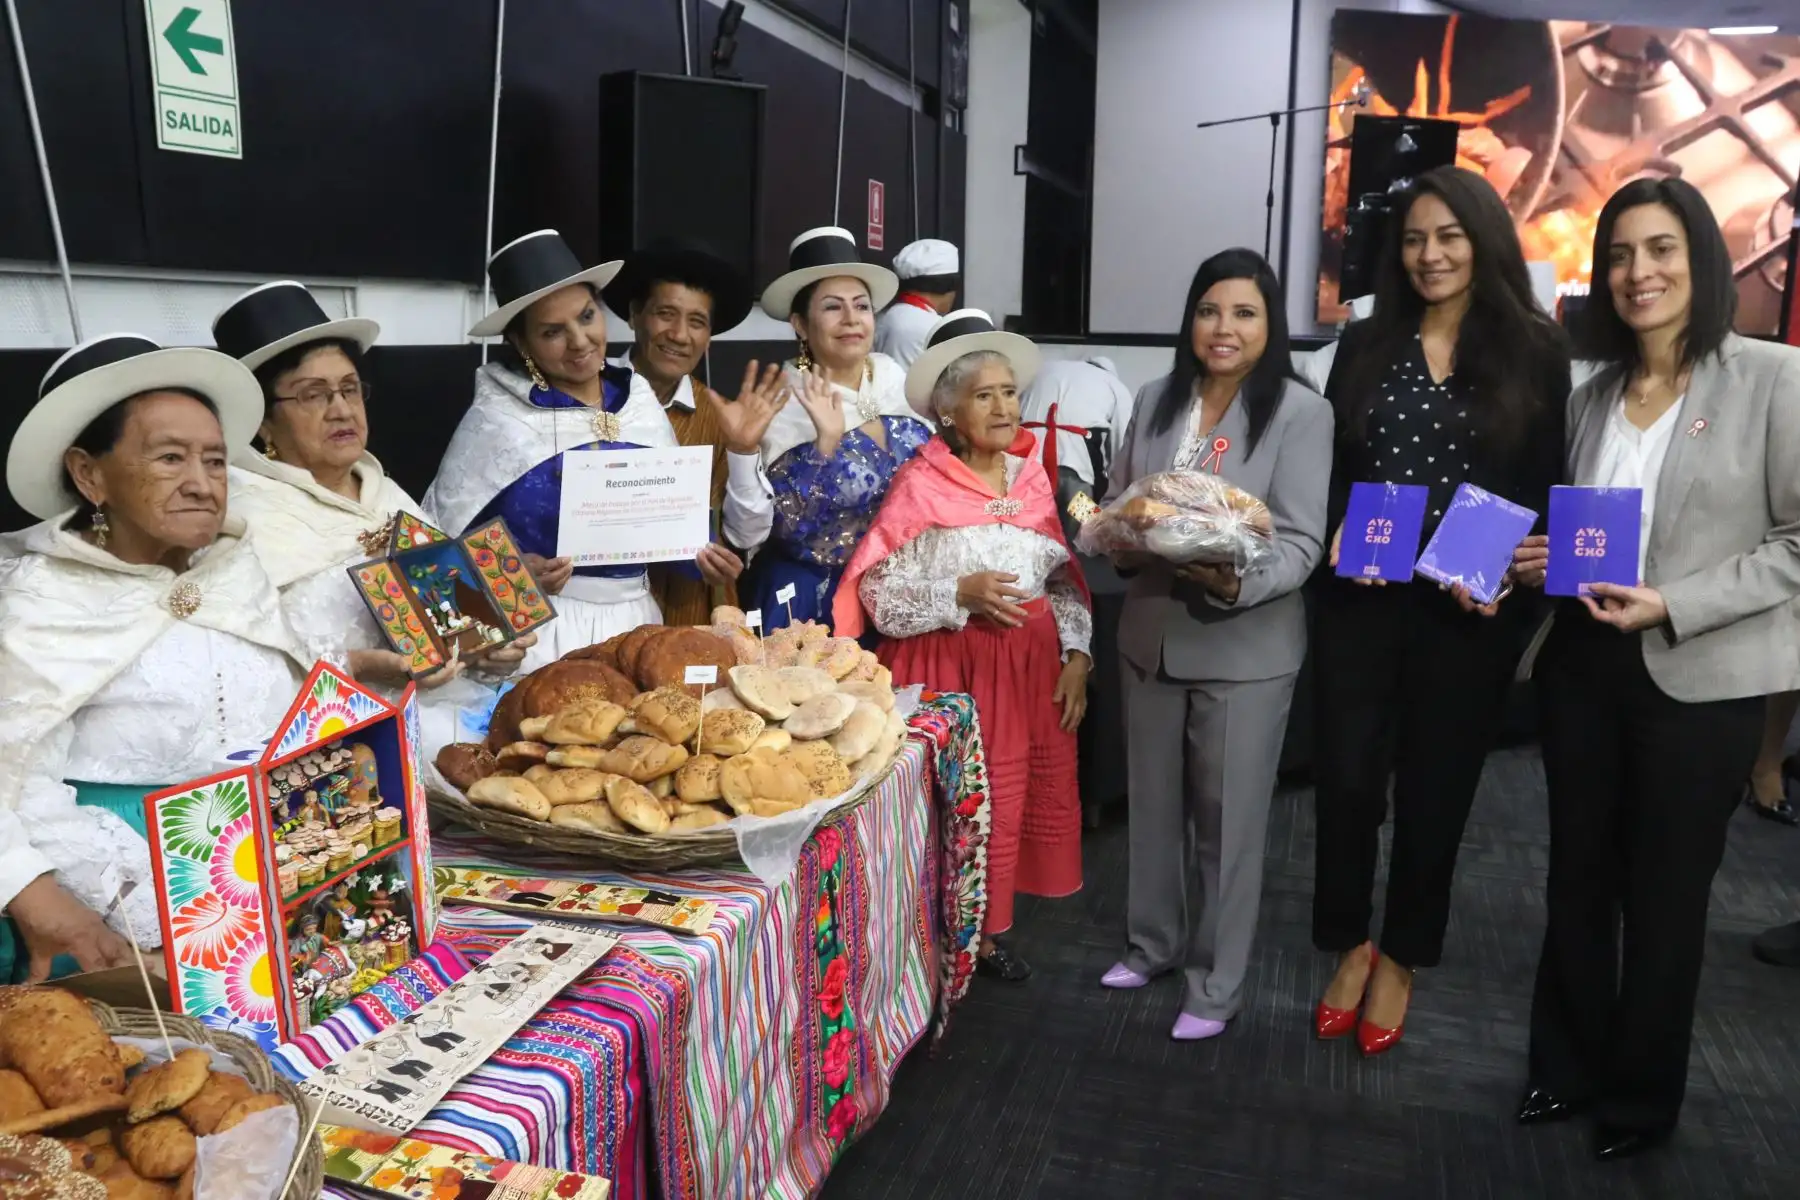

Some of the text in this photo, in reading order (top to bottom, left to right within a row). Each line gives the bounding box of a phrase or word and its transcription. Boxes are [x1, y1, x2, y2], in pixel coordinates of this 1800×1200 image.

[165, 110, 234, 137] SALIDA
[605, 476, 676, 489] Reconocimiento
[1367, 518, 1393, 527] AYA
[1575, 527, 1607, 537] AYA
[1365, 535, 1390, 544] CHO
[1574, 547, 1605, 557] CHO
